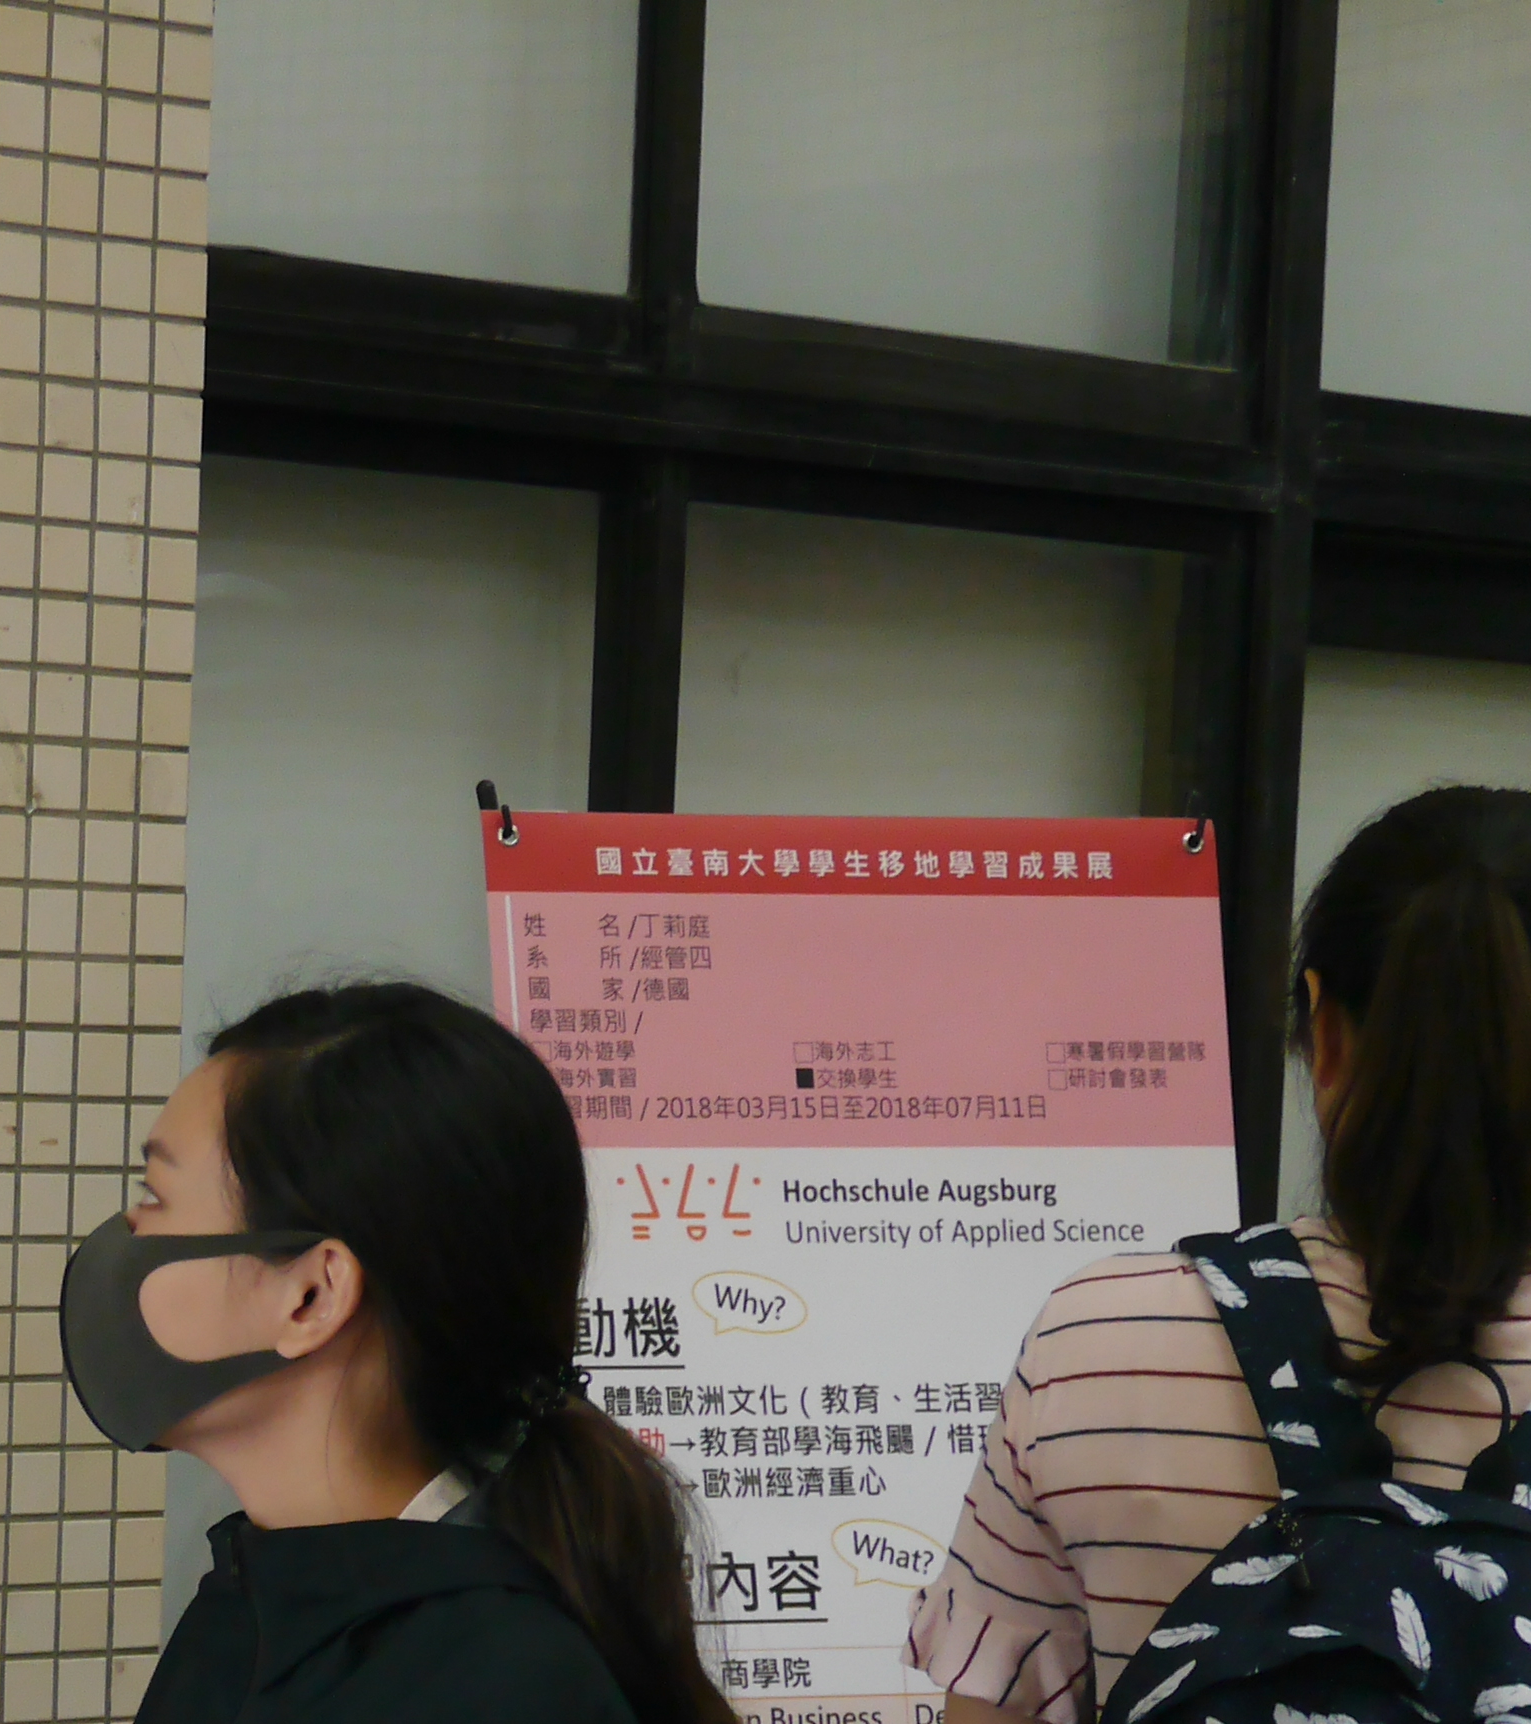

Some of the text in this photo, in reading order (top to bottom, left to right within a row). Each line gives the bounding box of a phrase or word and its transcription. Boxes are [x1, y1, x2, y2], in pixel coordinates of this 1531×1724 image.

[595, 846, 1114, 880] 國立臺南大學學生移地學習成果展
[530, 1009, 627, 1034] 學習類別
[553, 1040, 635, 1062] 海外遊學
[815, 1041, 896, 1062] 海外志工
[817, 1068, 897, 1089] 交換學生
[568, 1097, 632, 1121] 習期間
[656, 1096, 1047, 1121] 2018年03月15日至2018年07月11日
[783, 1179, 1057, 1207] Hochschule Augsburg
[786, 1218, 1144, 1248] University of Applied Science
[714, 1282, 787, 1322] Why?
[573, 1296, 681, 1359] 動機
[702, 1465, 887, 1499] 歐洲經濟重心
[853, 1530, 935, 1575] What?
